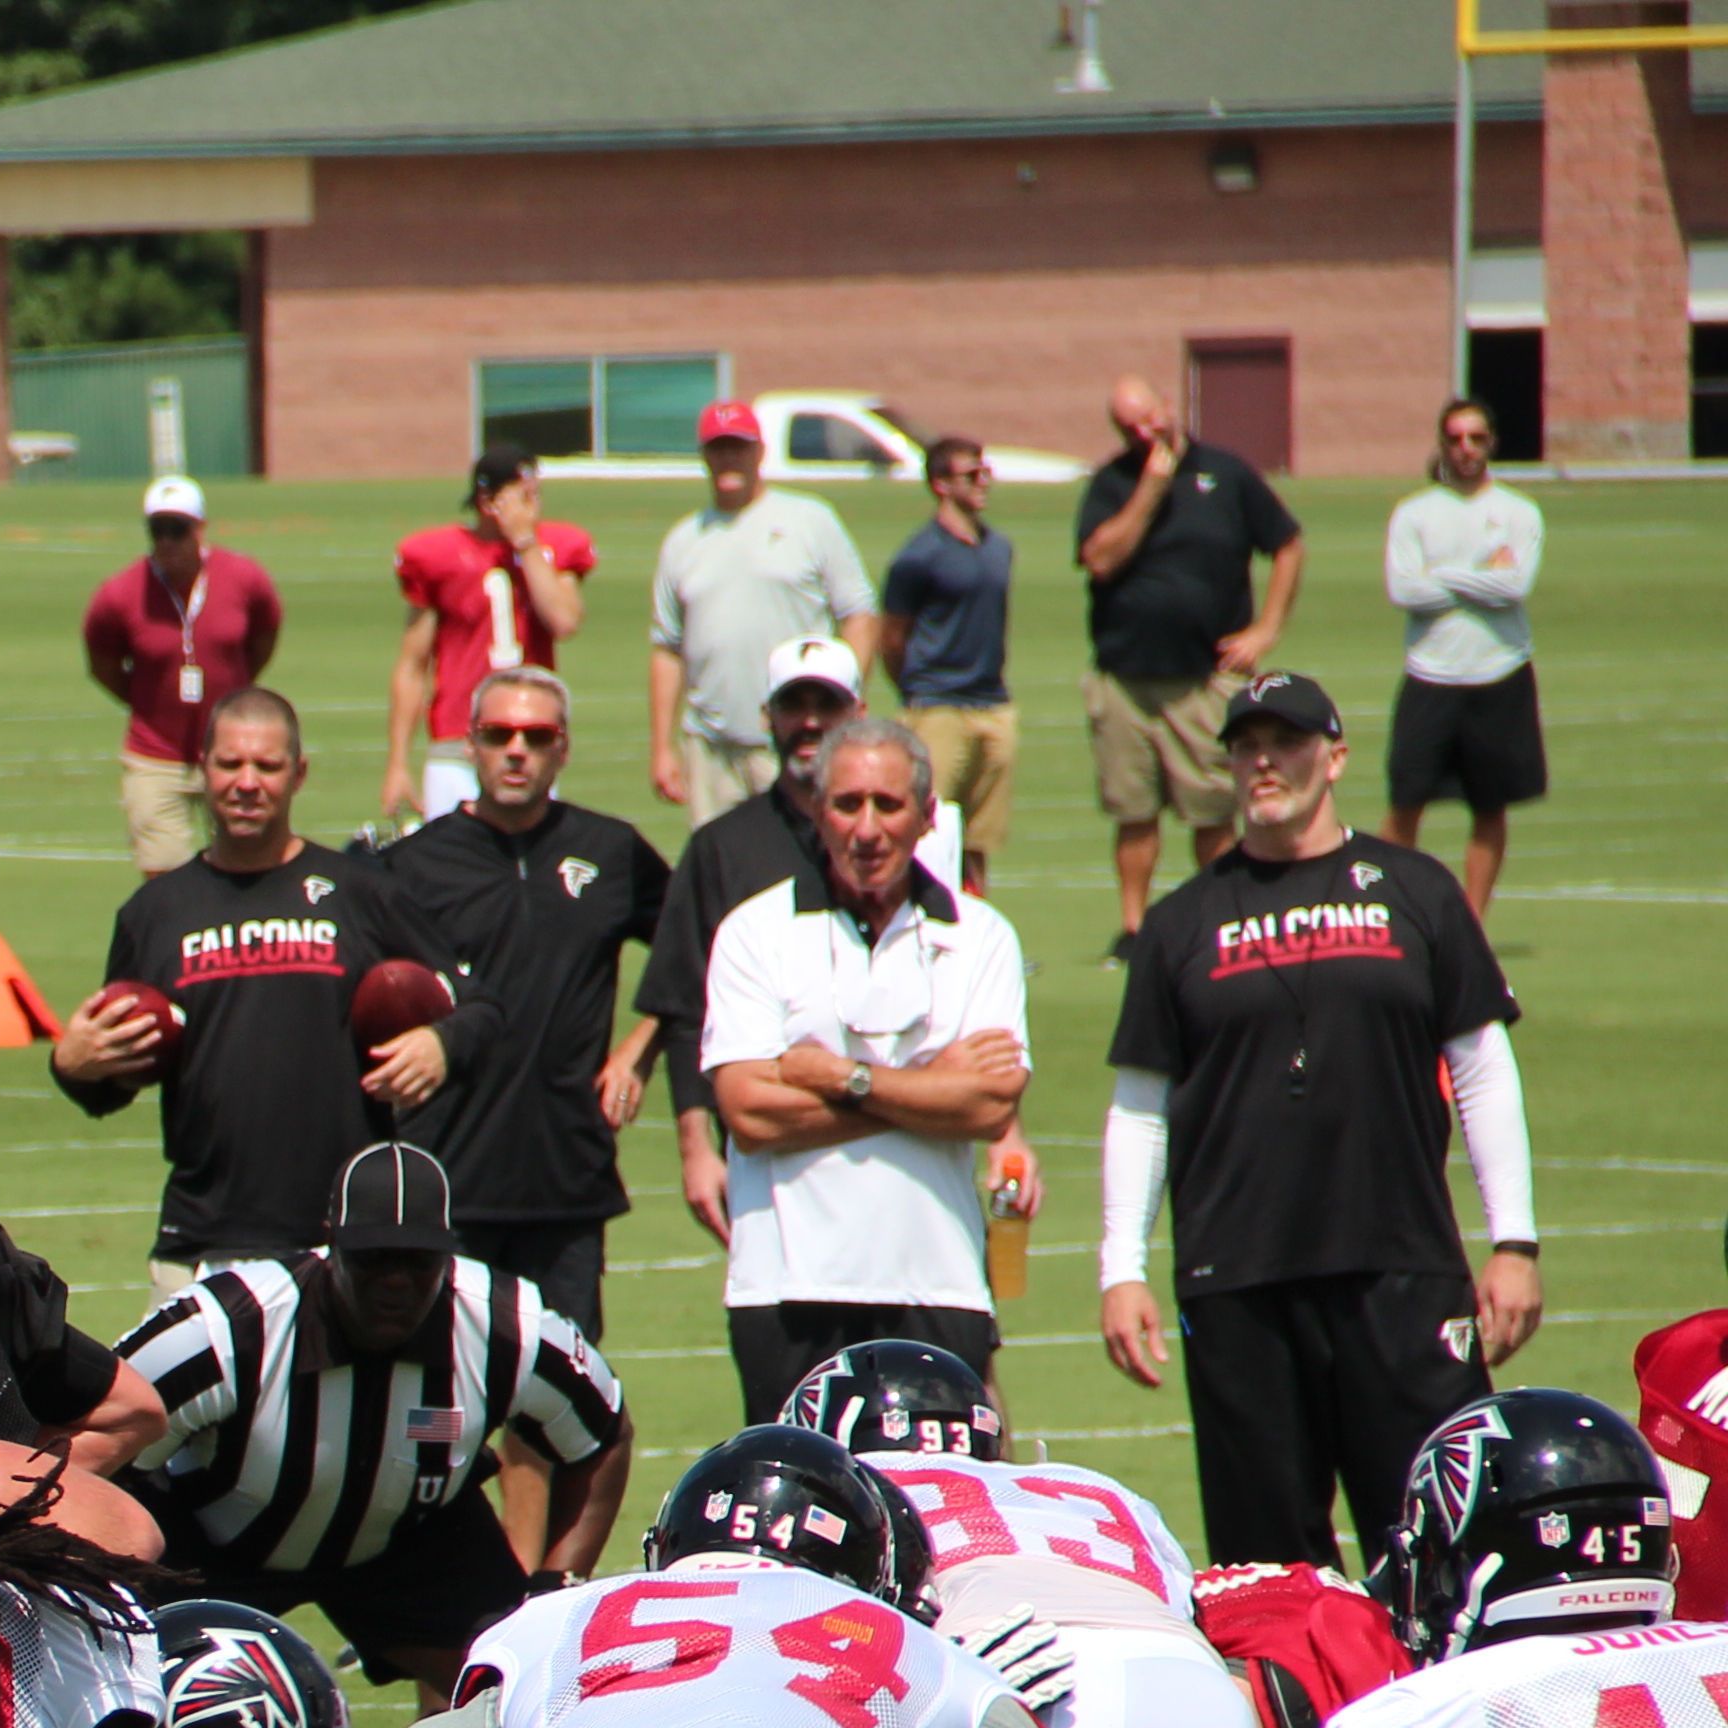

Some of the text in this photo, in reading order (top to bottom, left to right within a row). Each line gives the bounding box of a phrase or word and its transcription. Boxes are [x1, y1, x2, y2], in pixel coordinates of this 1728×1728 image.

[180, 918, 339, 976] FALCONS
[1217, 903, 1391, 966] FALCONS
[919, 1419, 972, 1455] 93
[418, 1476, 444, 1503] U
[733, 1503, 795, 1550] 54
[1545, 1526, 1567, 1543] NFL
[1580, 1524, 1642, 1563] 45
[1558, 1591, 1660, 1607] FALCONS
[1572, 1622, 1728, 1656] JONE
